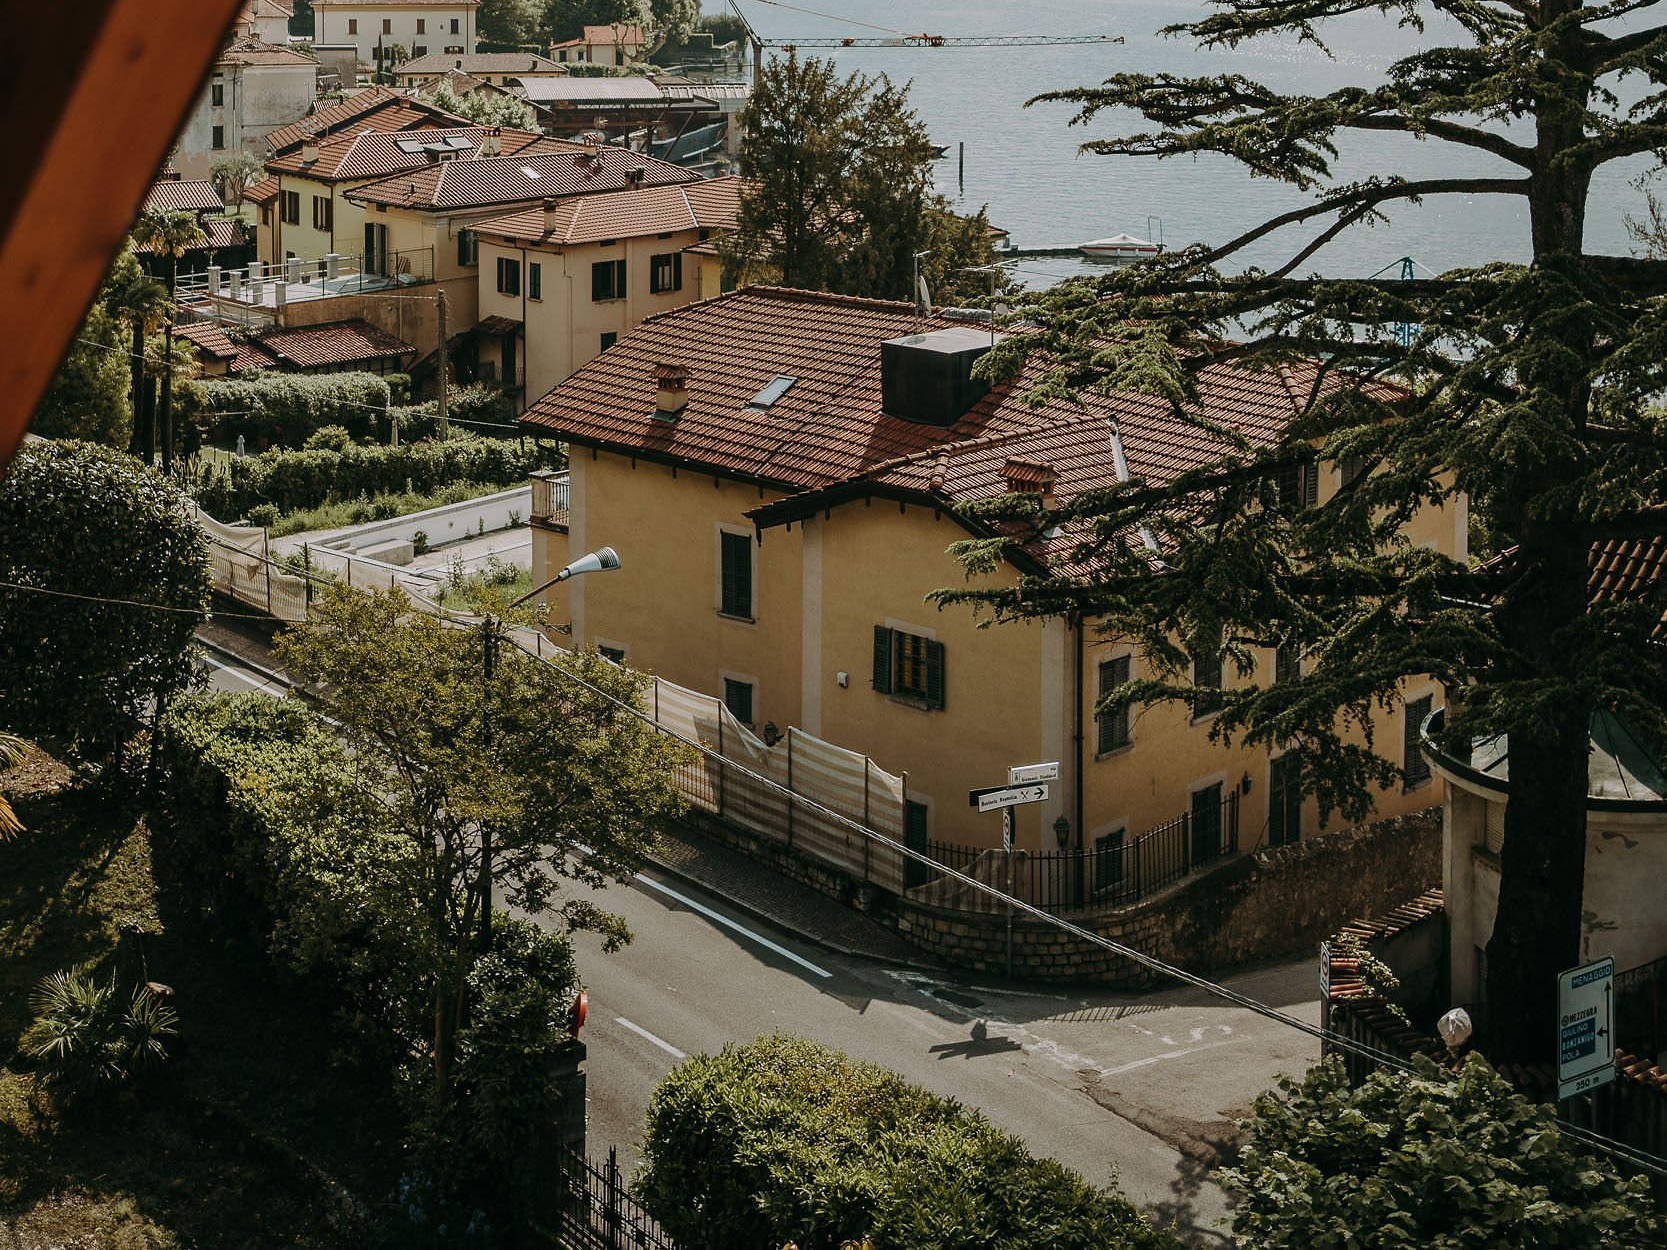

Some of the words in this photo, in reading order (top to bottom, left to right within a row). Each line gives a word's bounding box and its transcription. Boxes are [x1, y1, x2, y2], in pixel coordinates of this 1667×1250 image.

[1573, 966, 1611, 986] MENAGGIO
[1569, 1006, 1598, 1023] MEZZEGRA
[1562, 1023, 1589, 1038] GIULINO
[1562, 1049, 1580, 1062] POLA
[1576, 1078, 1590, 1091] 250
[1592, 1076, 1600, 1085] m
